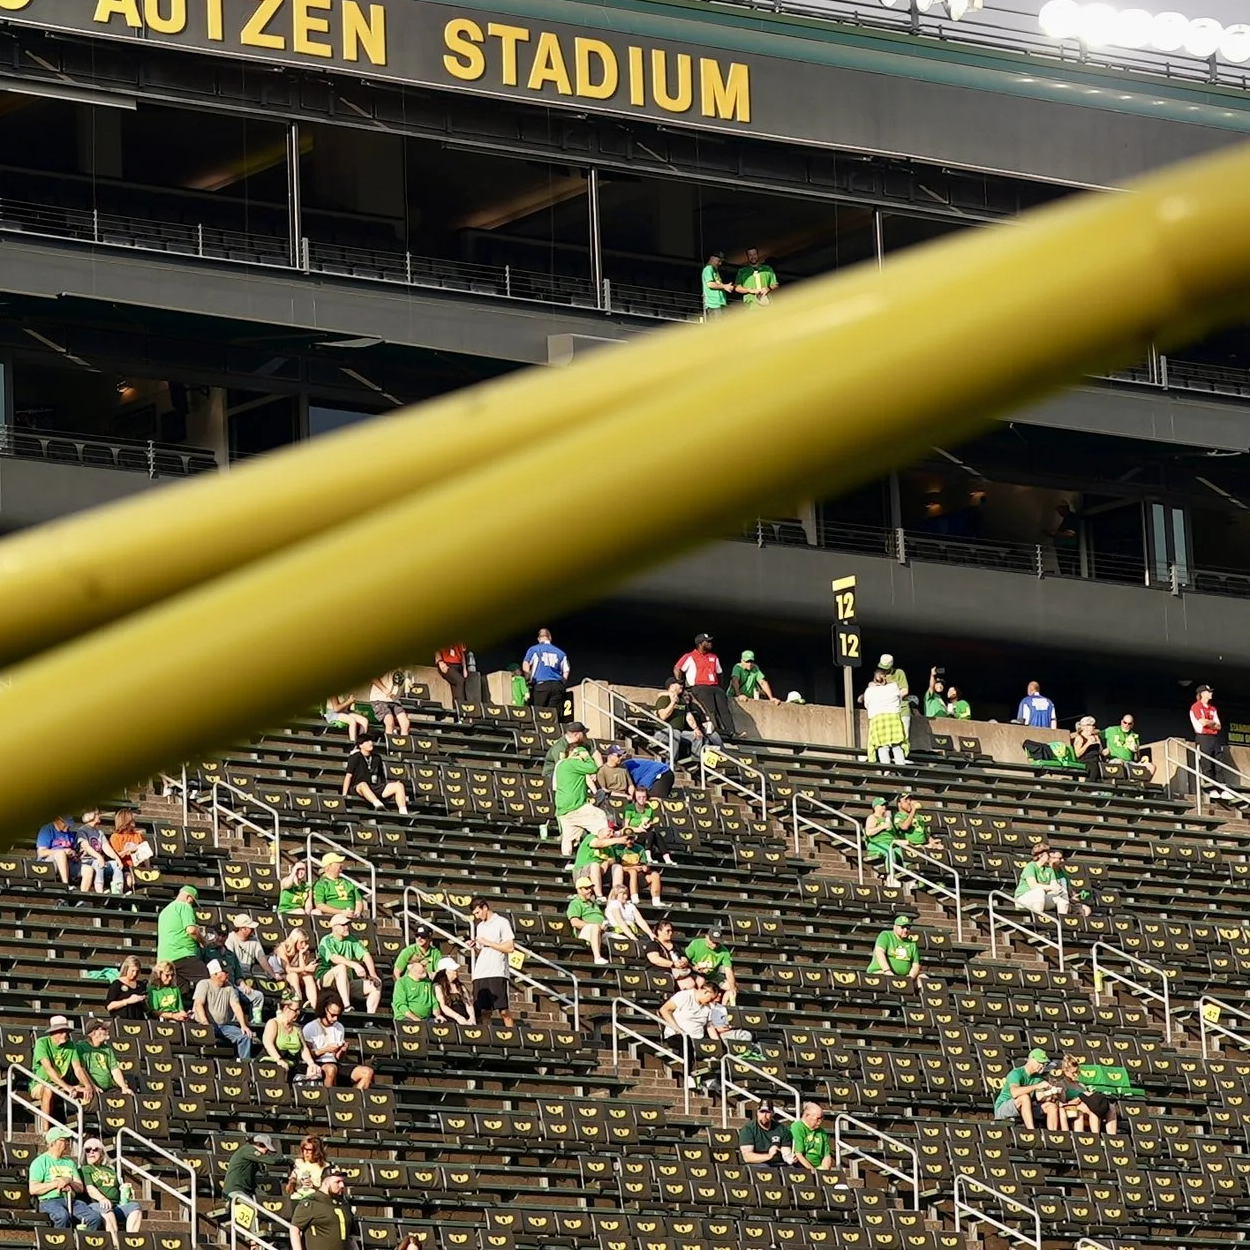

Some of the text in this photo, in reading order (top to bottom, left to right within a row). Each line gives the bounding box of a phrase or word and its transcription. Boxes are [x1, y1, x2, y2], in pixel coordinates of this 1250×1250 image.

[443, 18, 751, 123] STADIUM
[836, 592, 854, 620] 12
[839, 633, 859, 657] 12
